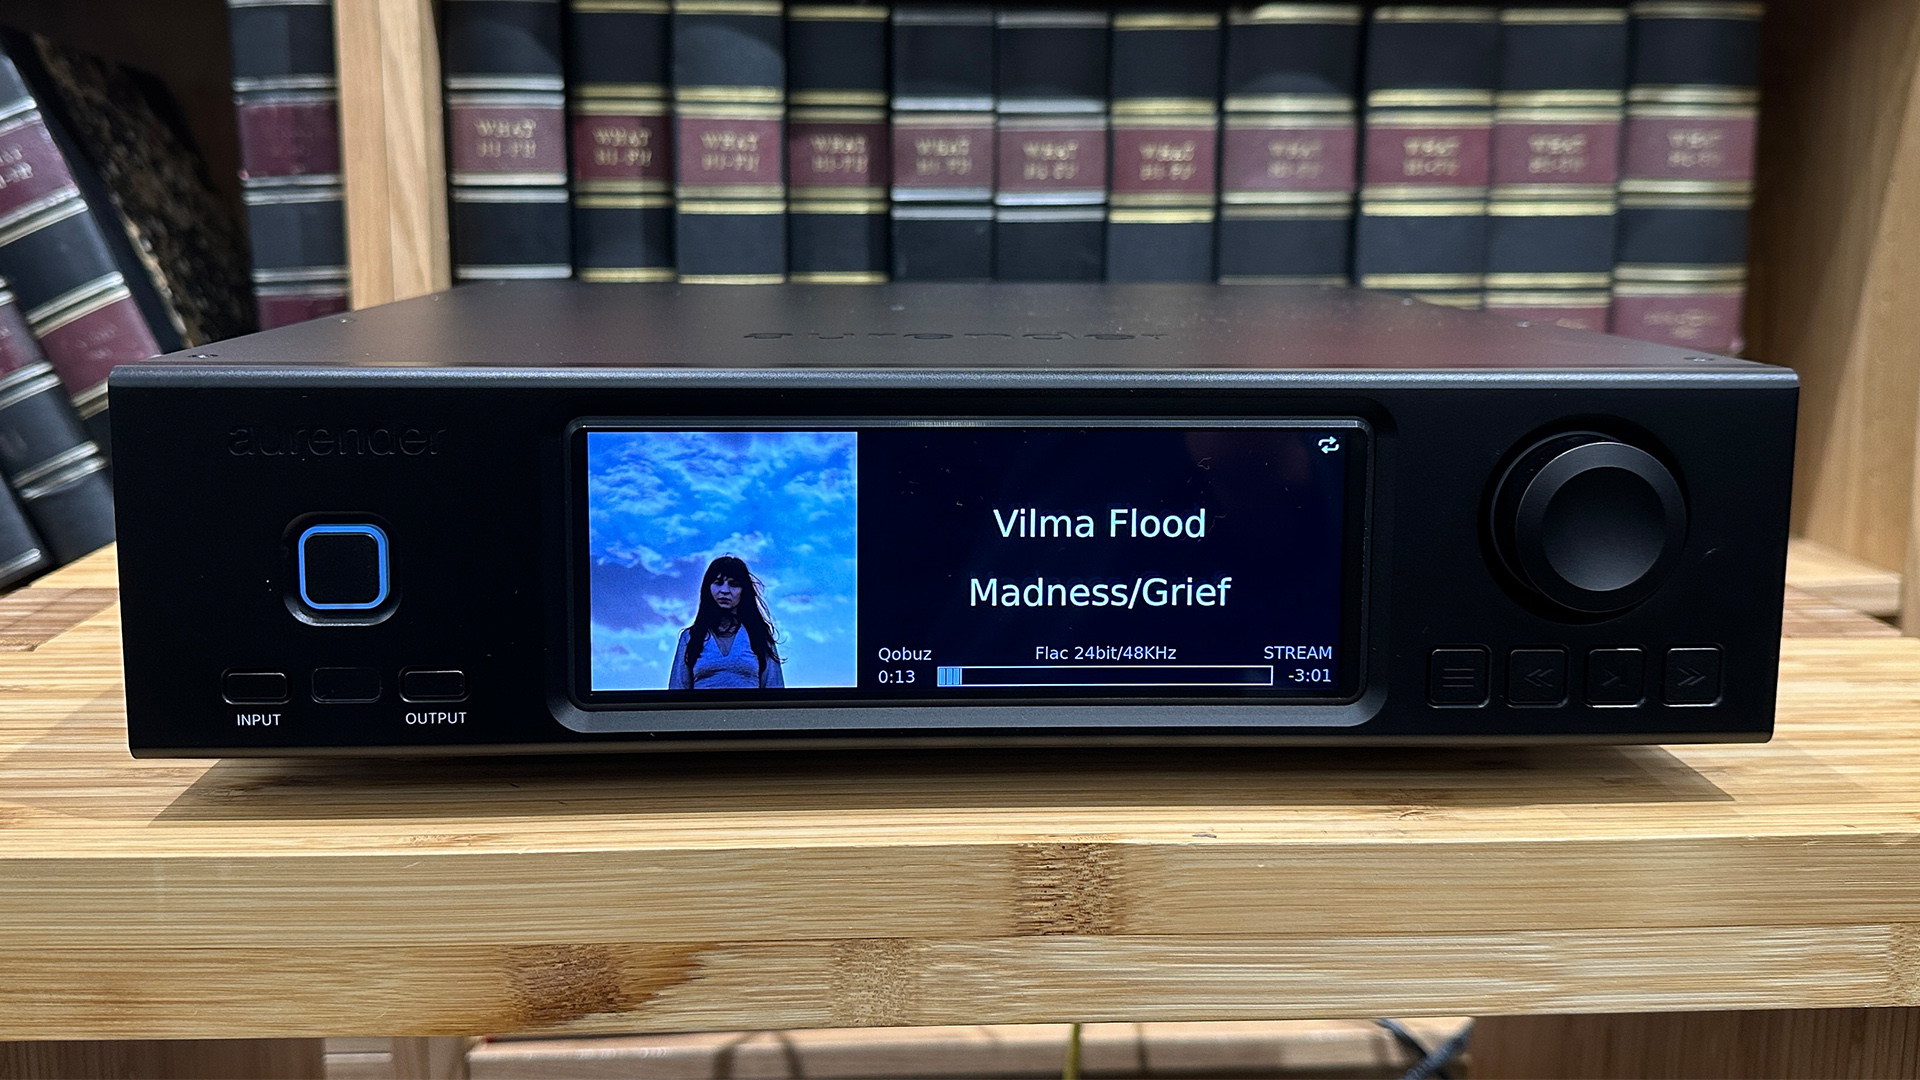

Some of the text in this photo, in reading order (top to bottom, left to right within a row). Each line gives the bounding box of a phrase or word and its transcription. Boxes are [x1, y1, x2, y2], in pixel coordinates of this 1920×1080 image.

[228, 424, 447, 456] aurender
[993, 508, 1206, 538] Vilma Flood
[970, 577, 1233, 610] Madness/Grief
[878, 646, 932, 663] Qobuz
[1035, 645, 1177, 661] Flac 24bit/48KHz
[1263, 645, 1333, 660] STREAM
[878, 669, 916, 684] 0:13
[1288, 668, 1332, 683] -3:01
[236, 713, 281, 727] INPUT
[405, 711, 467, 725] OUTPUT
